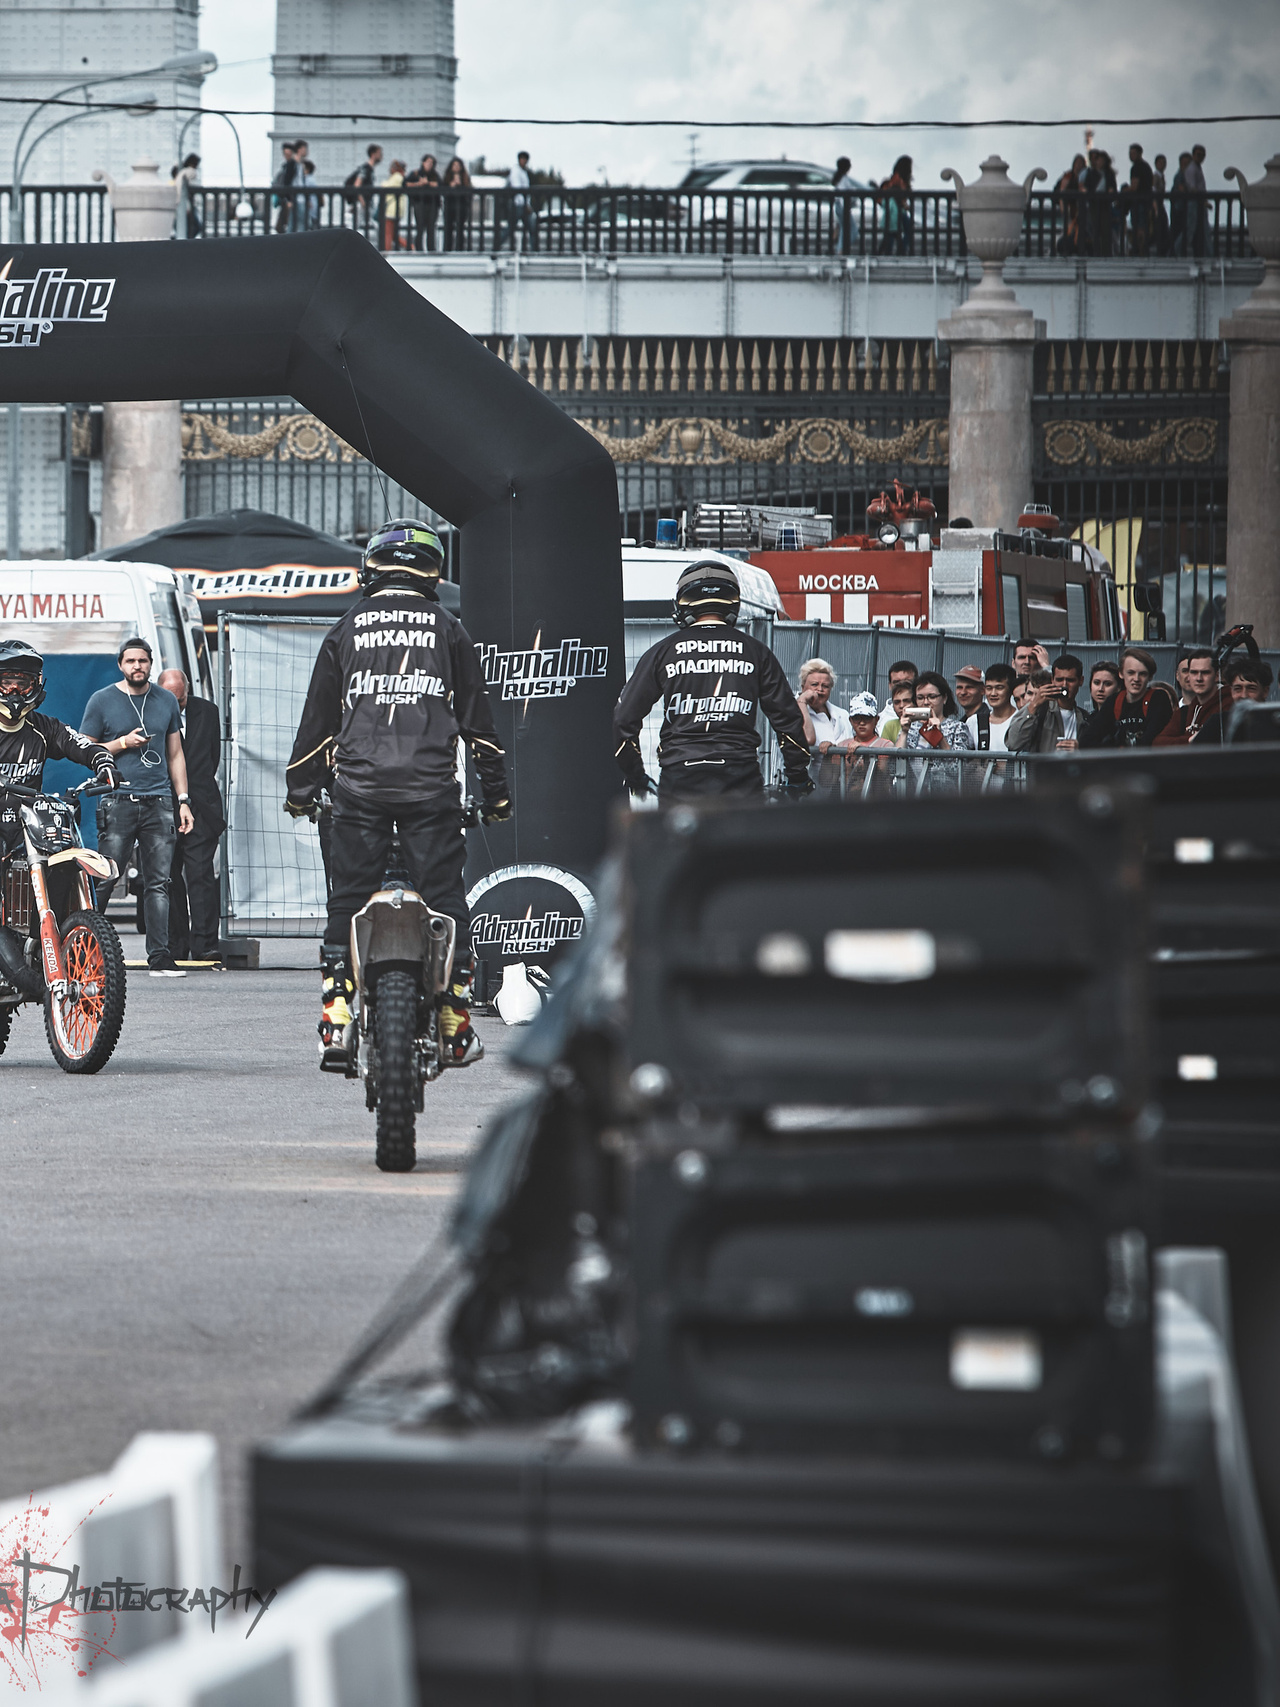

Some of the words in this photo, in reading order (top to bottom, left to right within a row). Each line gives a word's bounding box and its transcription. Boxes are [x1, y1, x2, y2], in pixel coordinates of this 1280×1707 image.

[798, 574, 879, 591] МОСКВА
[353, 610, 436, 629] ЯРЫГИН
[353, 629, 436, 651] МИХАИЛ
[675, 640, 743, 654] ЯРЫГИН
[665, 659, 755, 679] ВЛАДИМИР
[346, 668, 446, 710] Adrenaline
[665, 691, 753, 724] Adrenaline
[469, 911, 584, 960] Adrenaline
[43, 938, 59, 974] KENDA
